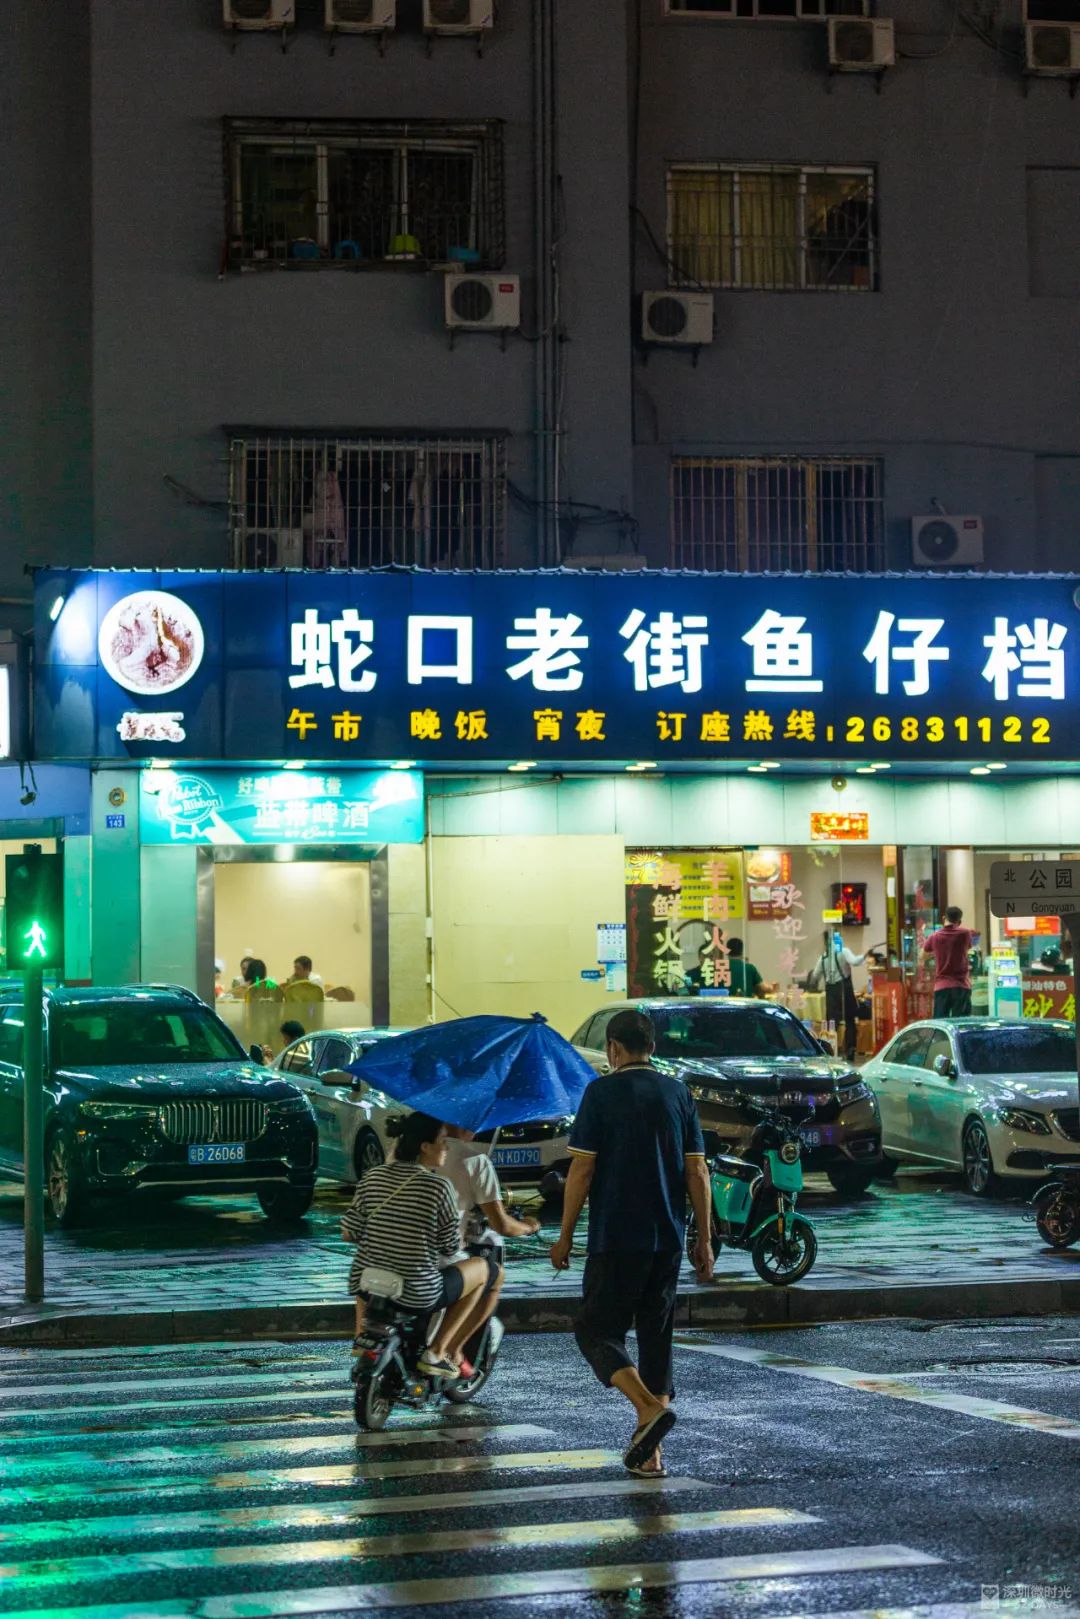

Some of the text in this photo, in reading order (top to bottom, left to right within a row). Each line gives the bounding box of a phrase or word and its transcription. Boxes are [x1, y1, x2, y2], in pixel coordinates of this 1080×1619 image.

[289, 608, 1068, 700] 蛇口老街鱼仔档
[286, 708, 362, 741] 午市
[410, 708, 489, 741] 晚饭
[533, 708, 606, 741] 宵夜
[254, 800, 369, 828] 蓝带啤酒
[1003, 868, 1073, 889] 北 公园
[1006, 902, 1075, 914] N Gongyuan
[700, 860, 732, 988] 羊肉火锅
